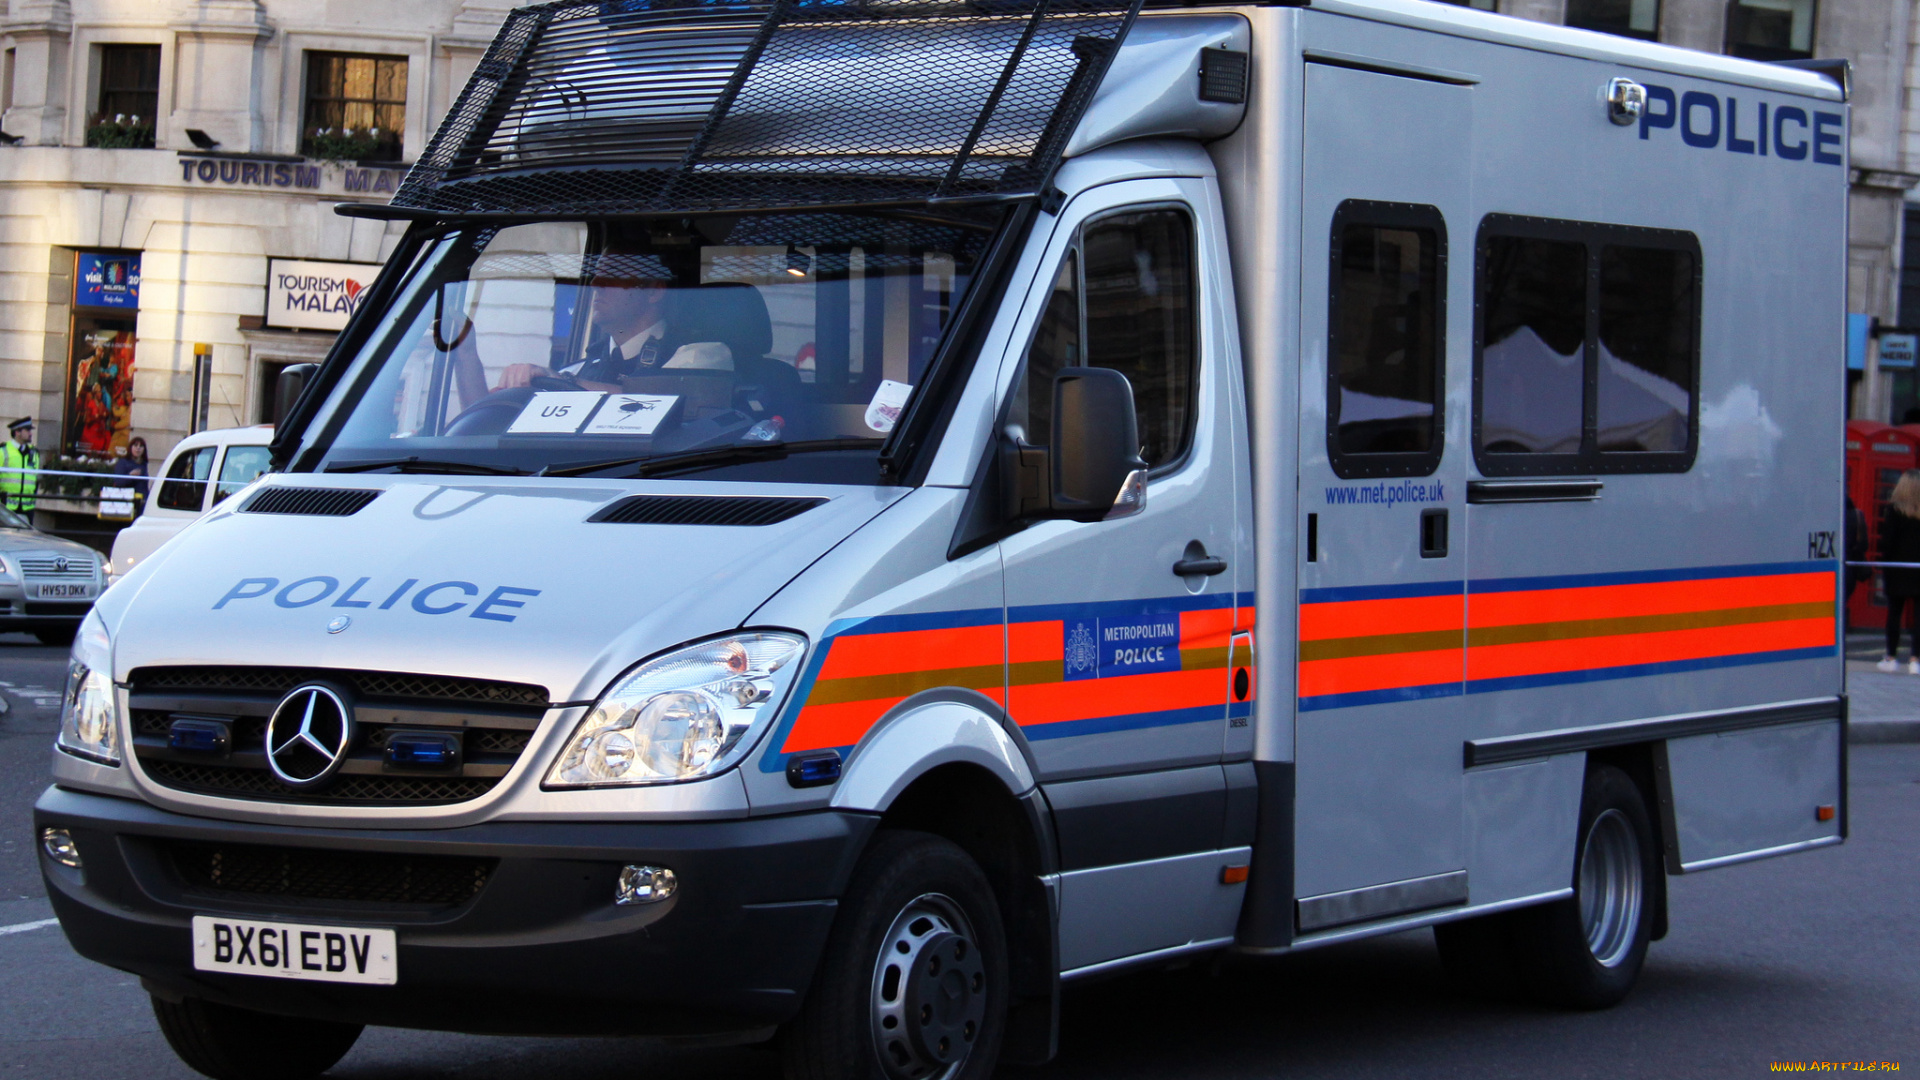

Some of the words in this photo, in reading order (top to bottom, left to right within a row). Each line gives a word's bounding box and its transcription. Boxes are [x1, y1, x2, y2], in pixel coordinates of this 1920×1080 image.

[1638, 83, 1842, 166] POLICE
[179, 159, 321, 188] TOURISM
[278, 274, 345, 292] TOURISM
[541, 405, 571, 418] U5
[1325, 479, 1445, 508] www.met.police.uk
[1808, 530, 1836, 559] HZX
[211, 575, 543, 623] POLICE
[1104, 623, 1175, 642] METROPOLITAN
[1114, 646, 1166, 665] POLICE
[1230, 717, 1248, 728] DIESEL
[213, 923, 290, 969] BX61
[300, 930, 371, 974] EBV
